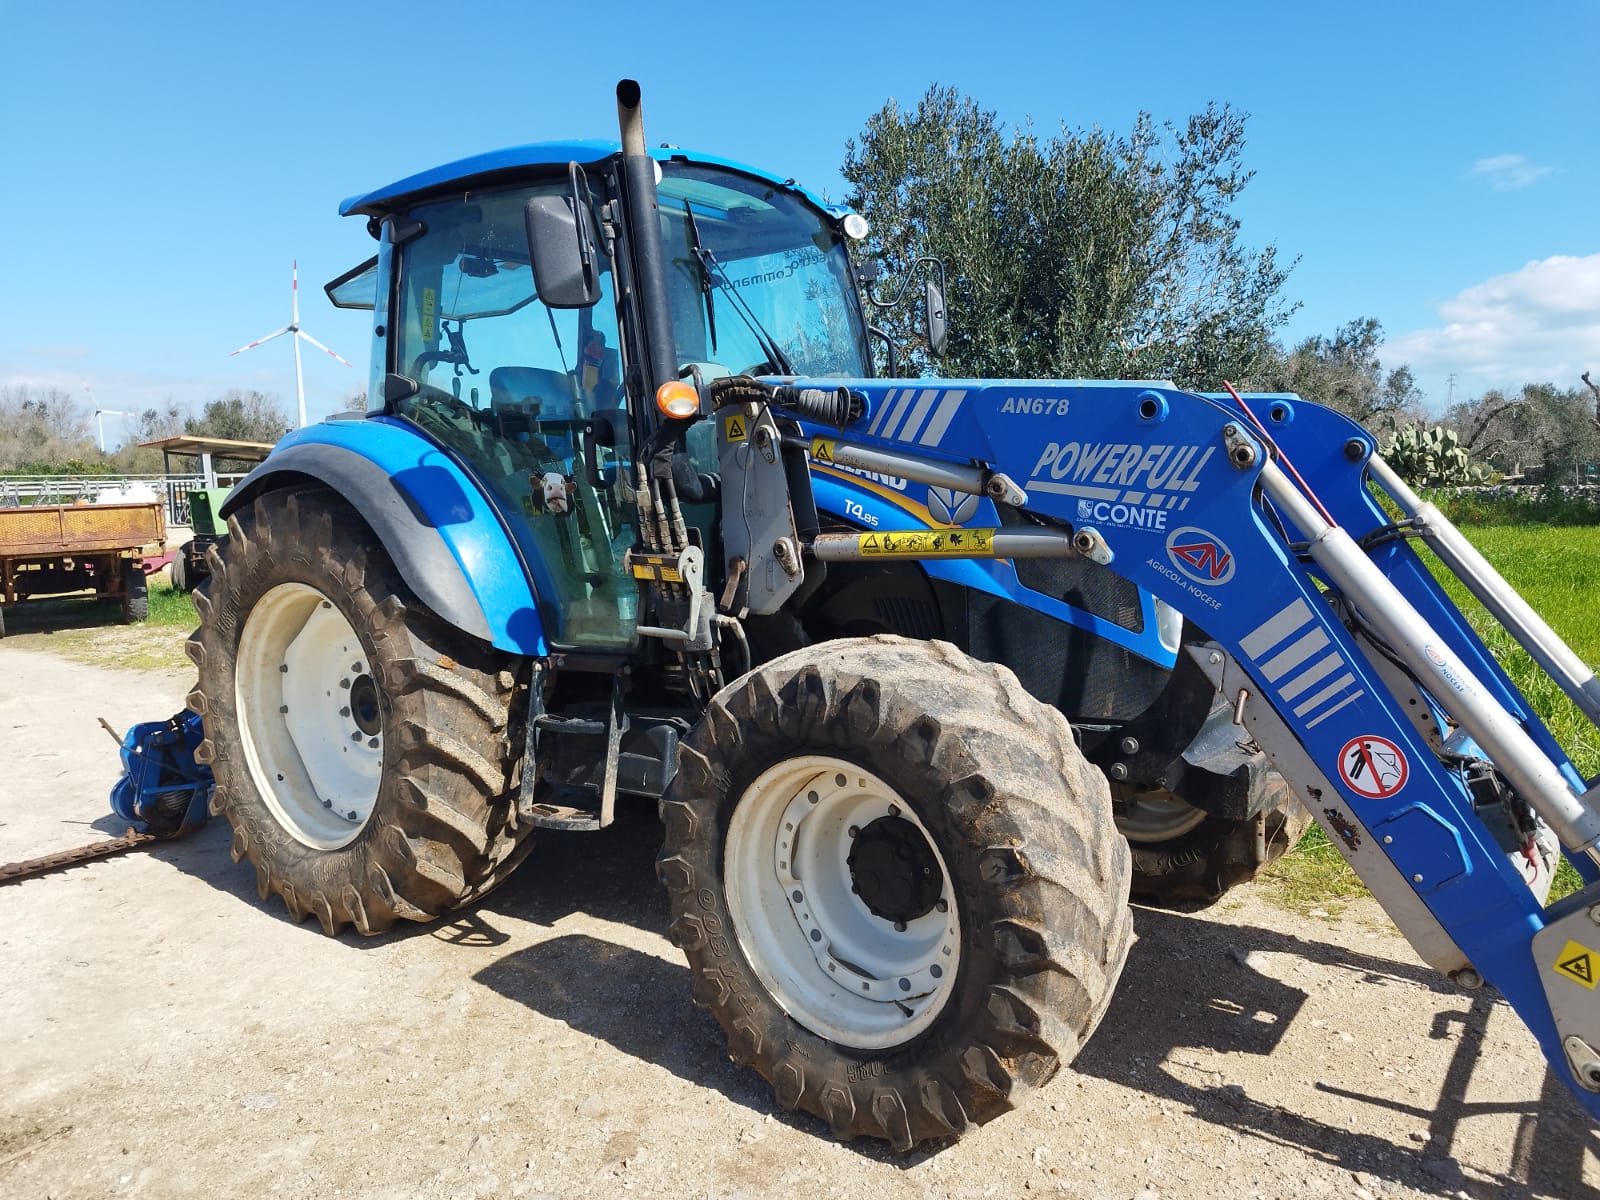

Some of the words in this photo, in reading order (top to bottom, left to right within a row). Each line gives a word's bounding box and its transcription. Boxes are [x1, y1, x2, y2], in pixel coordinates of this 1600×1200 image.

[1000, 397, 1070, 416] AN678
[1030, 441, 1216, 492] POWERFULL
[844, 499, 879, 527] T4.85
[1093, 501, 1168, 530] CONTE
[1145, 557, 1188, 590] AGRICOLA
[1187, 584, 1223, 611] NOCESE
